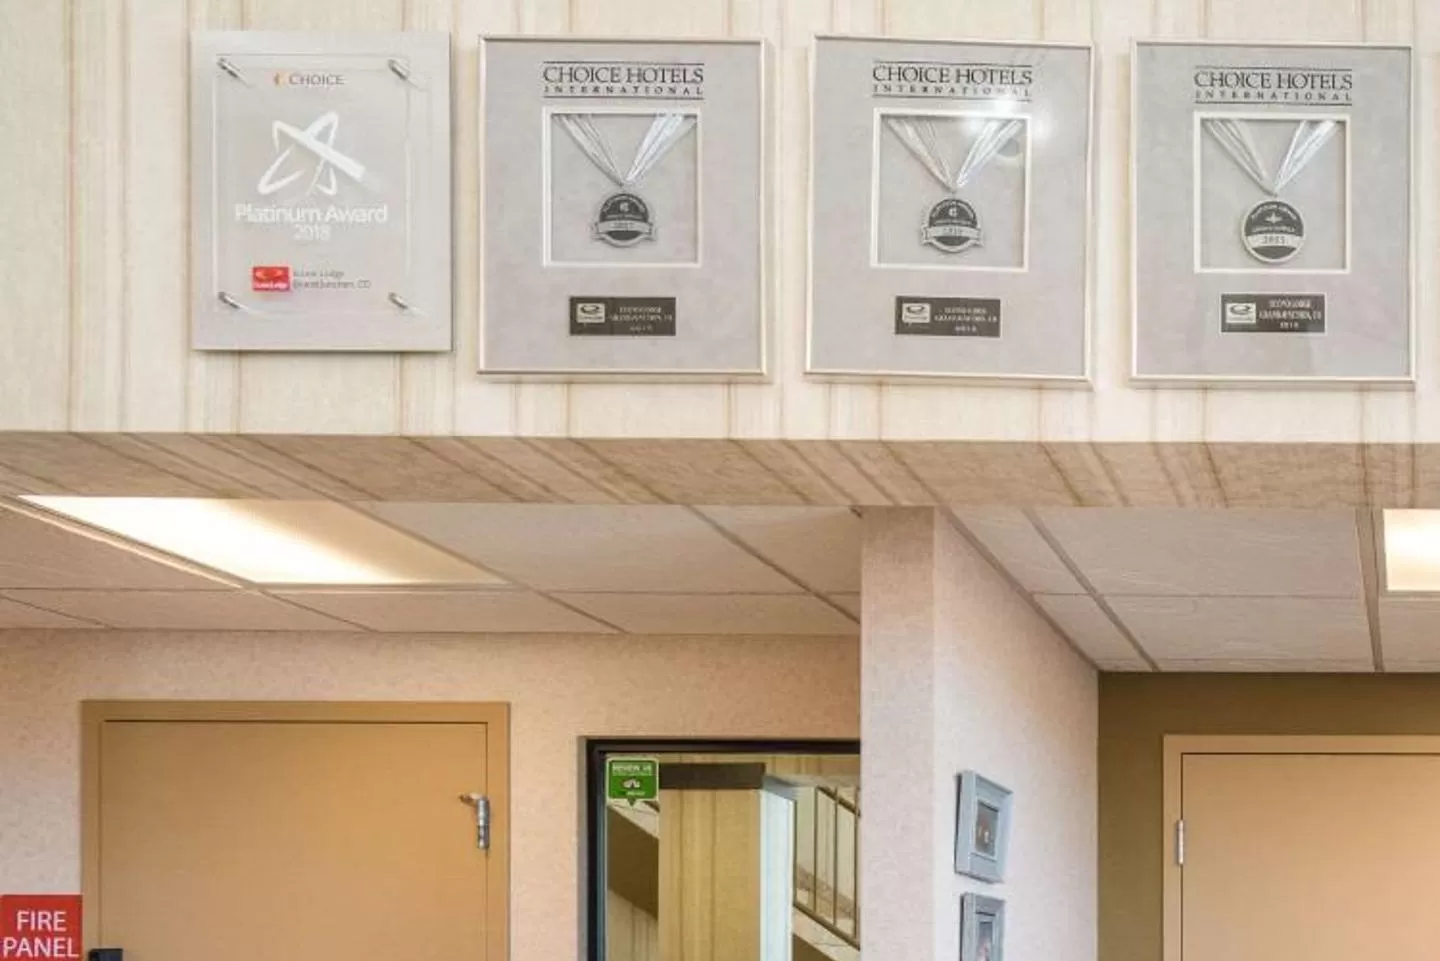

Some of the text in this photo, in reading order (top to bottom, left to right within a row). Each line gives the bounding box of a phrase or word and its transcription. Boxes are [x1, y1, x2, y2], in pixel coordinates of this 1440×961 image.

[289, 73, 345, 86] CHOICE
[543, 66, 704, 84] CHOICE HOTELS
[873, 66, 1032, 85] CHOICE HOTELS
[1194, 71, 1353, 90] CHOICE HOTELS
[544, 86, 703, 96] INTERNATIONAL
[1195, 90, 1352, 101] INTERNATIONAL
[235, 203, 389, 223] Platinum Award
[17, 910, 67, 932] FIRE
[3, 936, 80, 958] PANEL
